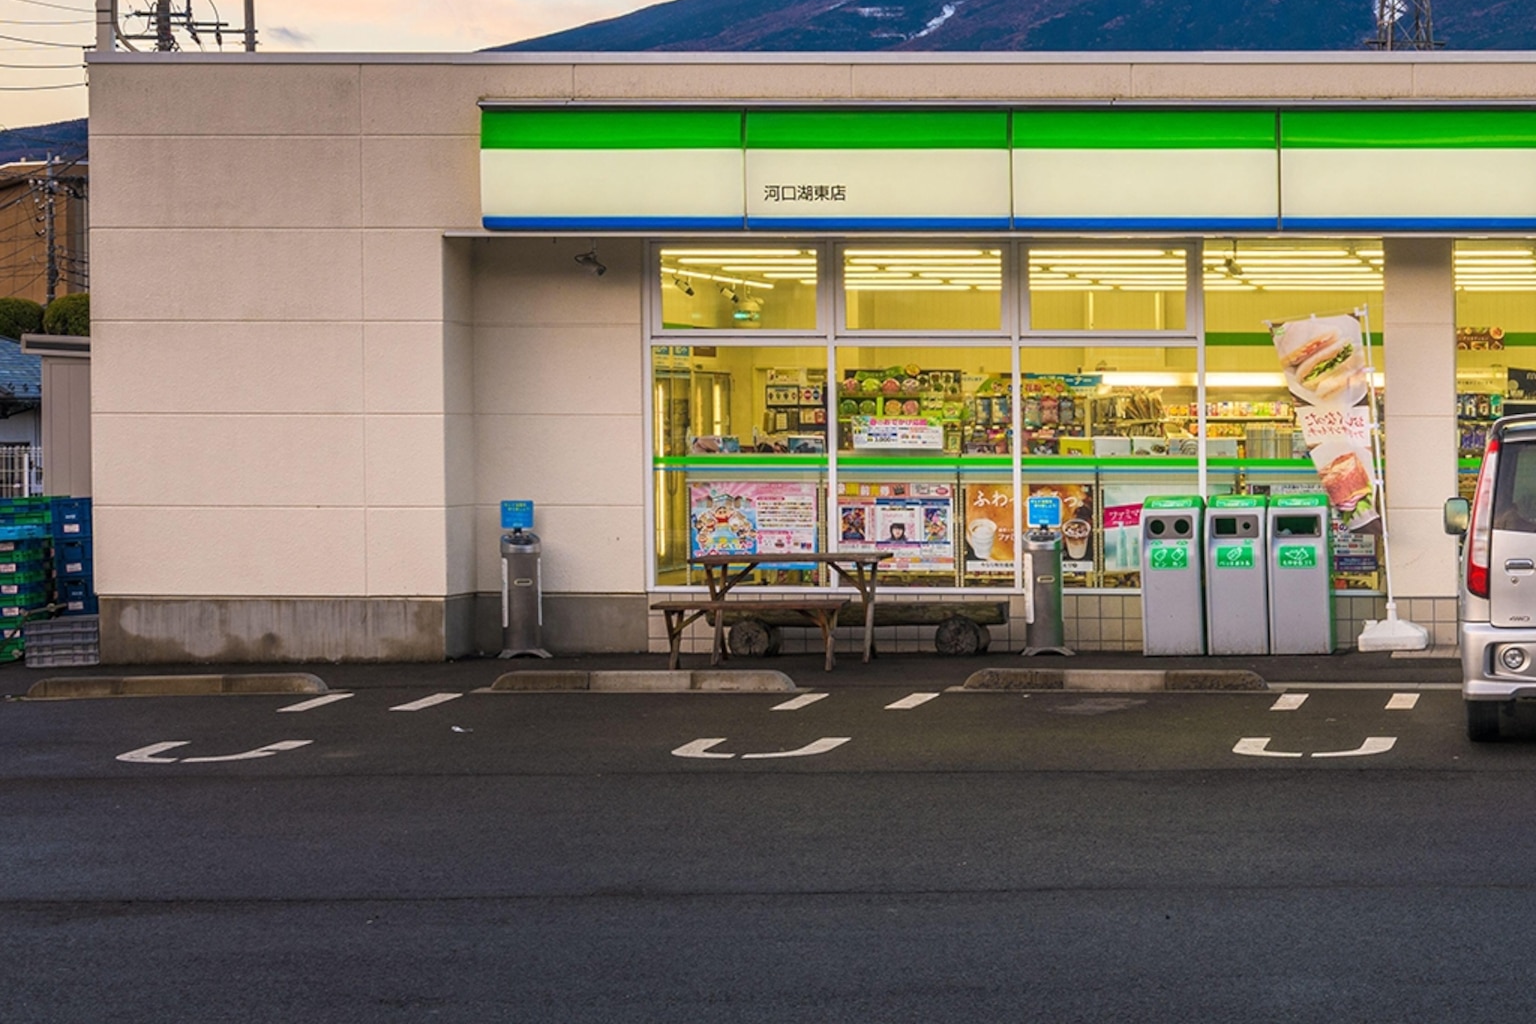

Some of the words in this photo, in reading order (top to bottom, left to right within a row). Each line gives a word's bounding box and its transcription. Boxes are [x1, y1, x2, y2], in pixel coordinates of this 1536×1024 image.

[764, 185, 846, 201] 河口湖東店
